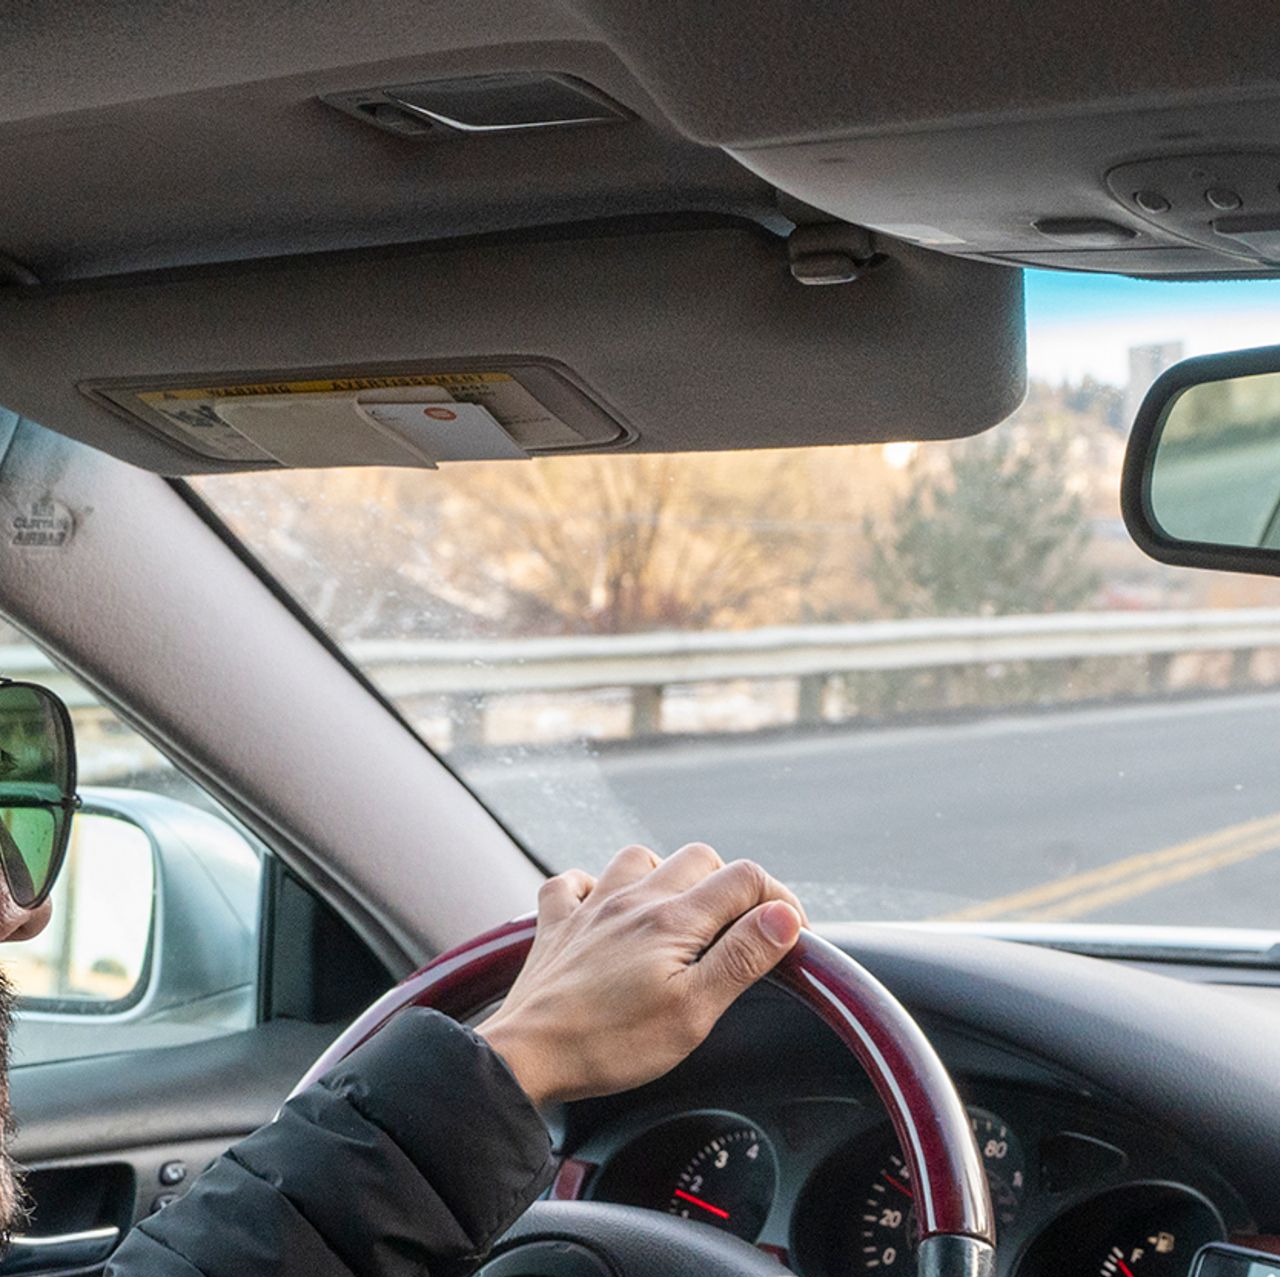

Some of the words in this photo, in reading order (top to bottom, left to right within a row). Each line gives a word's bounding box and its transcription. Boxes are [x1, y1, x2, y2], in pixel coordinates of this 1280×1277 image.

[746, 1143, 759, 1160] 4
[984, 1139, 1008, 1159] 80
[713, 1150, 729, 1169] 3
[690, 1175, 703, 1193] 2
[879, 1209, 902, 1229] 20
[882, 1247, 896, 1265] 0
[1130, 1248, 1144, 1264] F
